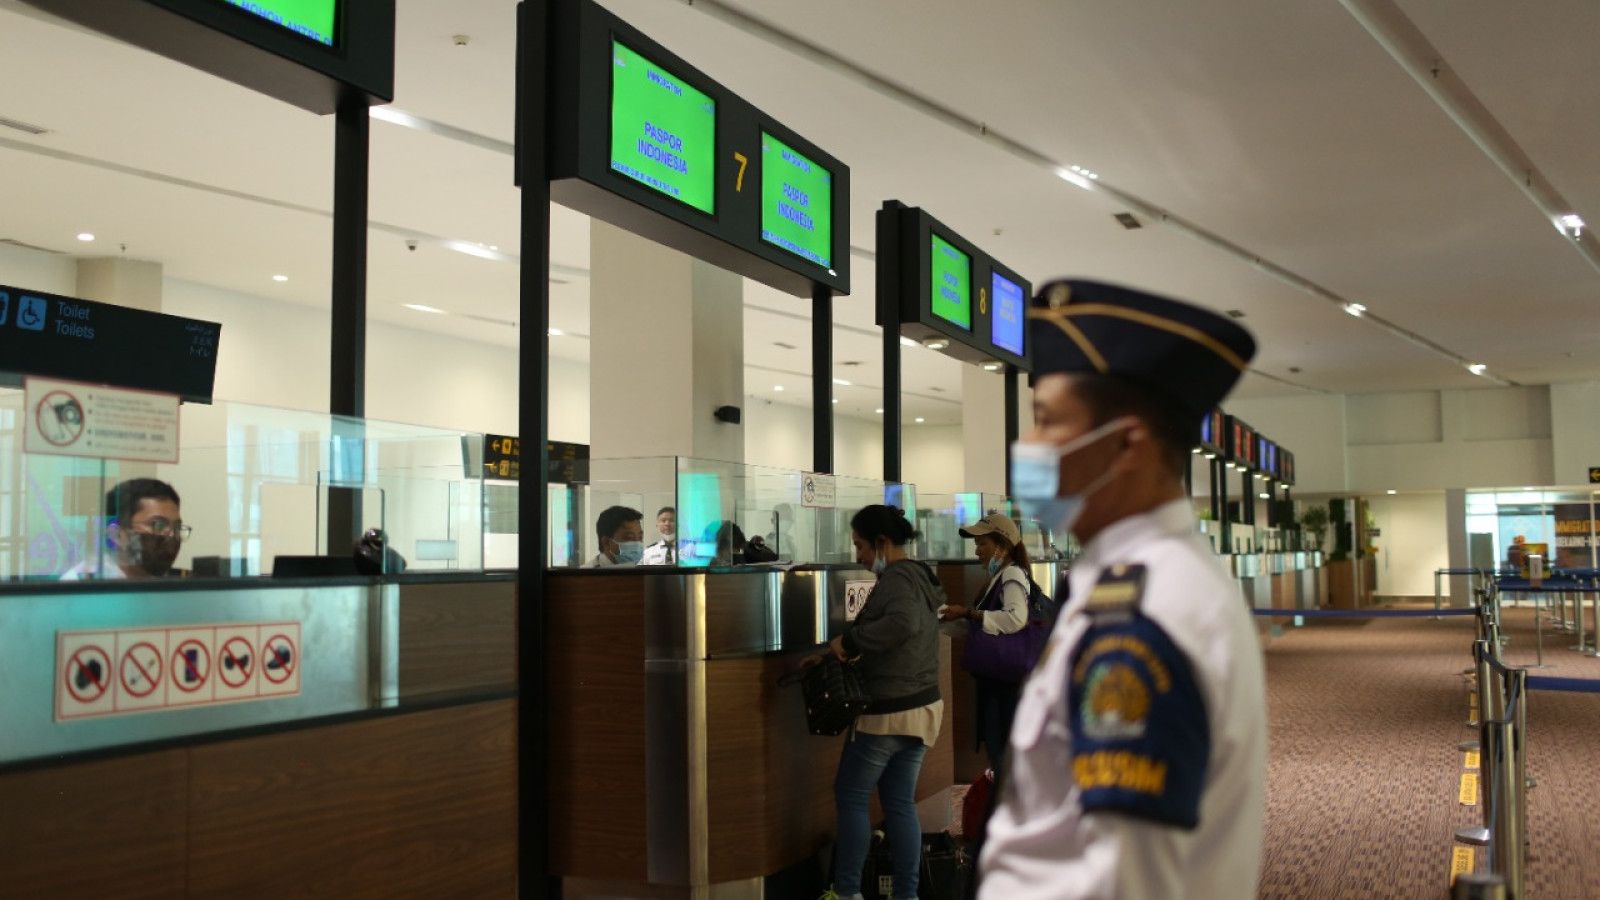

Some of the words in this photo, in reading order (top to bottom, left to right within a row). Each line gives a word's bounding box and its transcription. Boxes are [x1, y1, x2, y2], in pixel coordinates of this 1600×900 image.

[644, 121, 682, 153] PASPOR
[637, 138, 688, 175] INDONESIA
[734, 151, 748, 193] 7
[58, 302, 90, 321] Toilet
[979, 287, 986, 315] 8
[55, 319, 95, 339] Toilets
